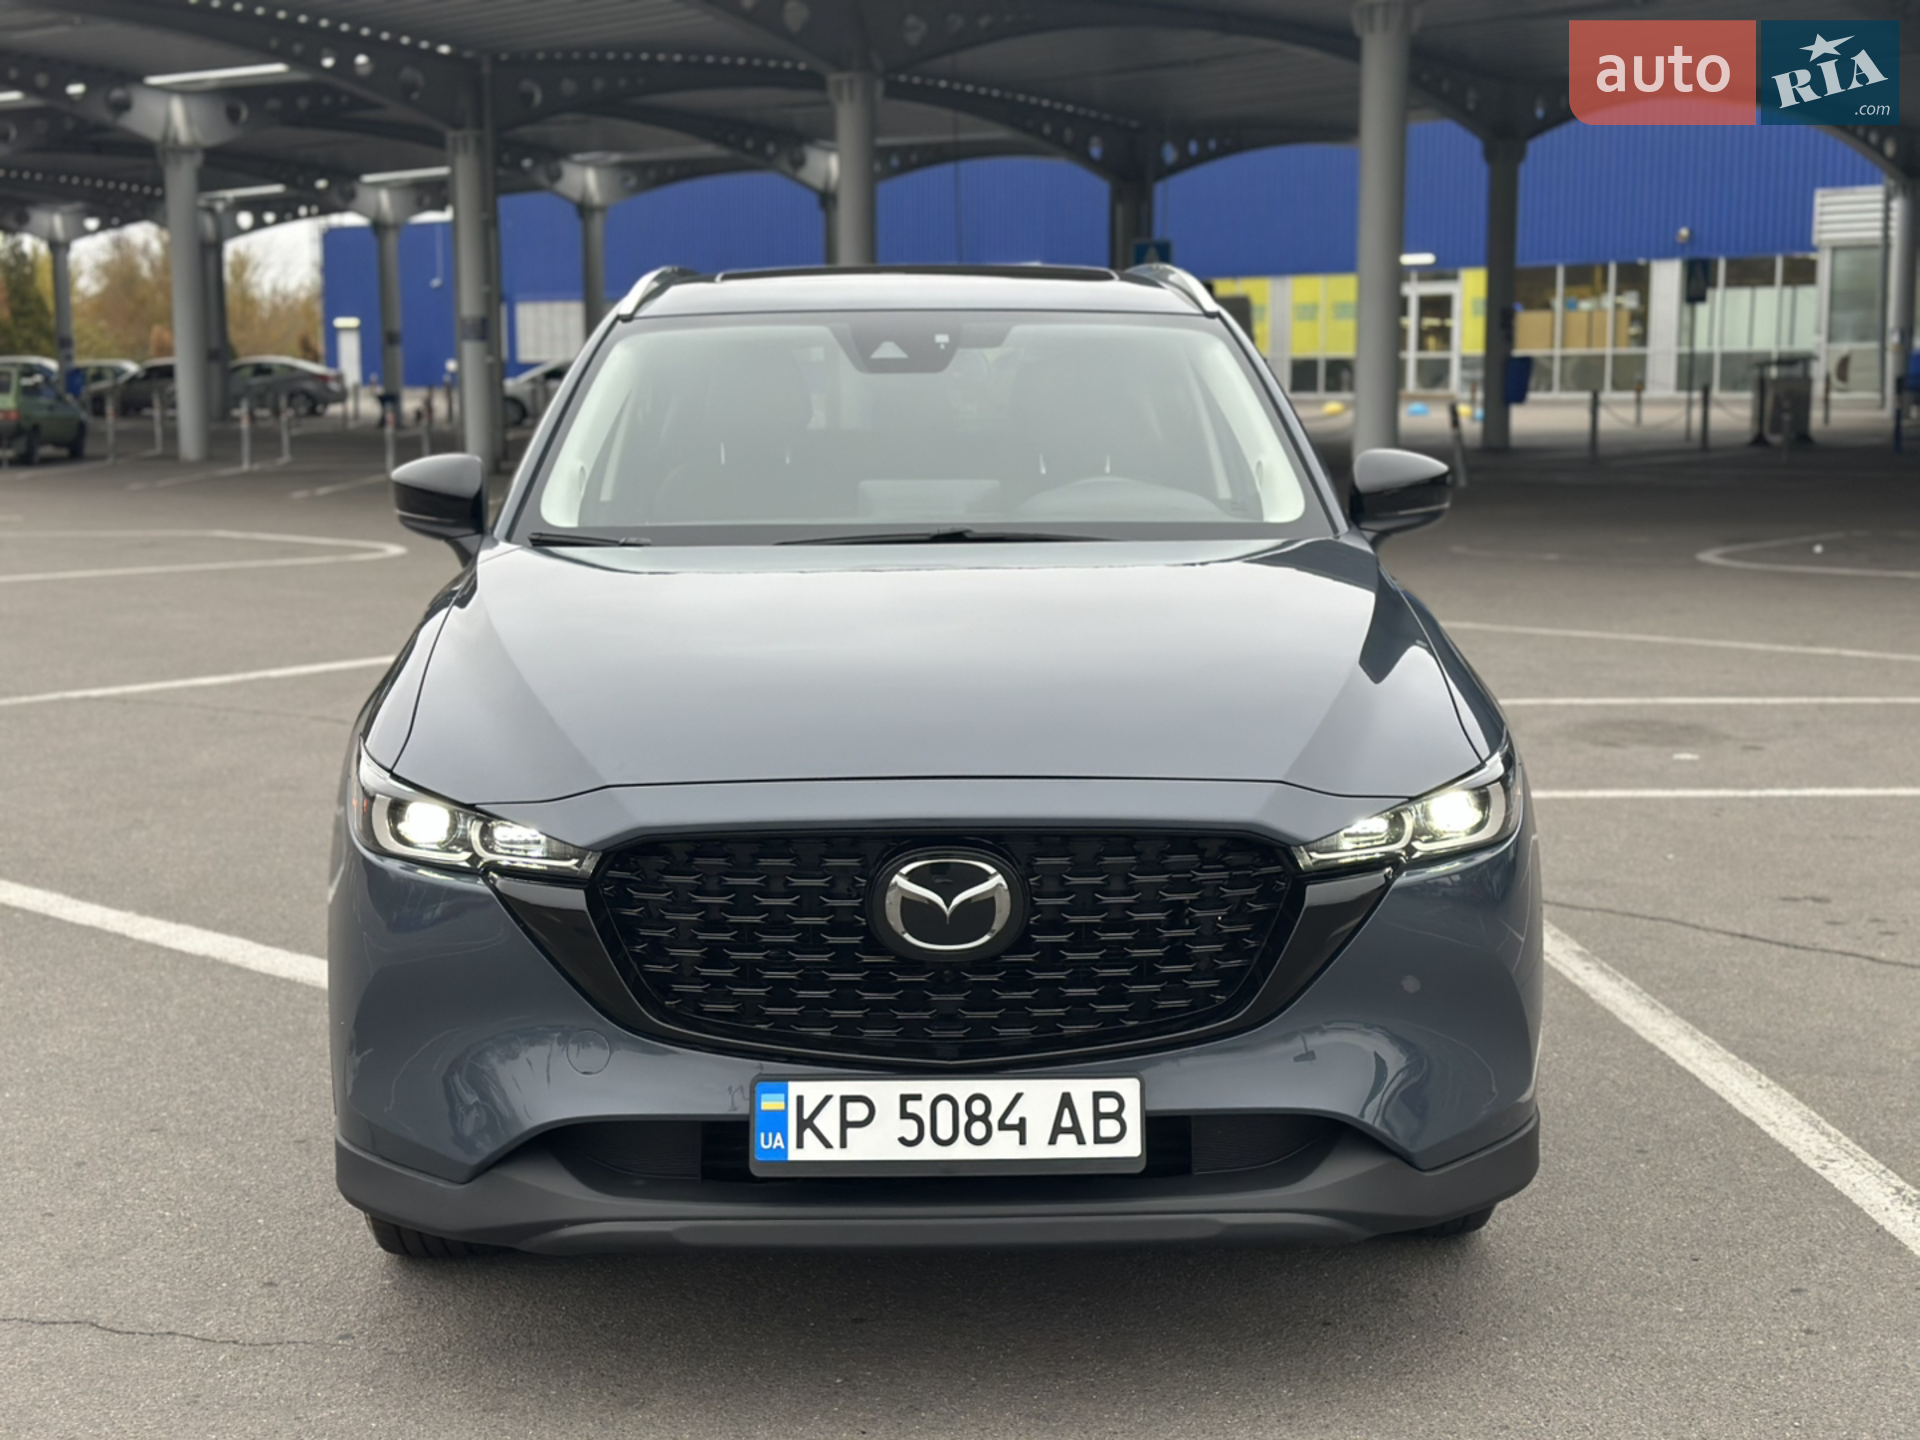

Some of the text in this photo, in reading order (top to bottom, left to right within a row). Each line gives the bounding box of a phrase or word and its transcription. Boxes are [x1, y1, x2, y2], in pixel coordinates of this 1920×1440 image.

[795, 1091, 1127, 1150] KP 5084 AB
[760, 1132, 785, 1149] UA
